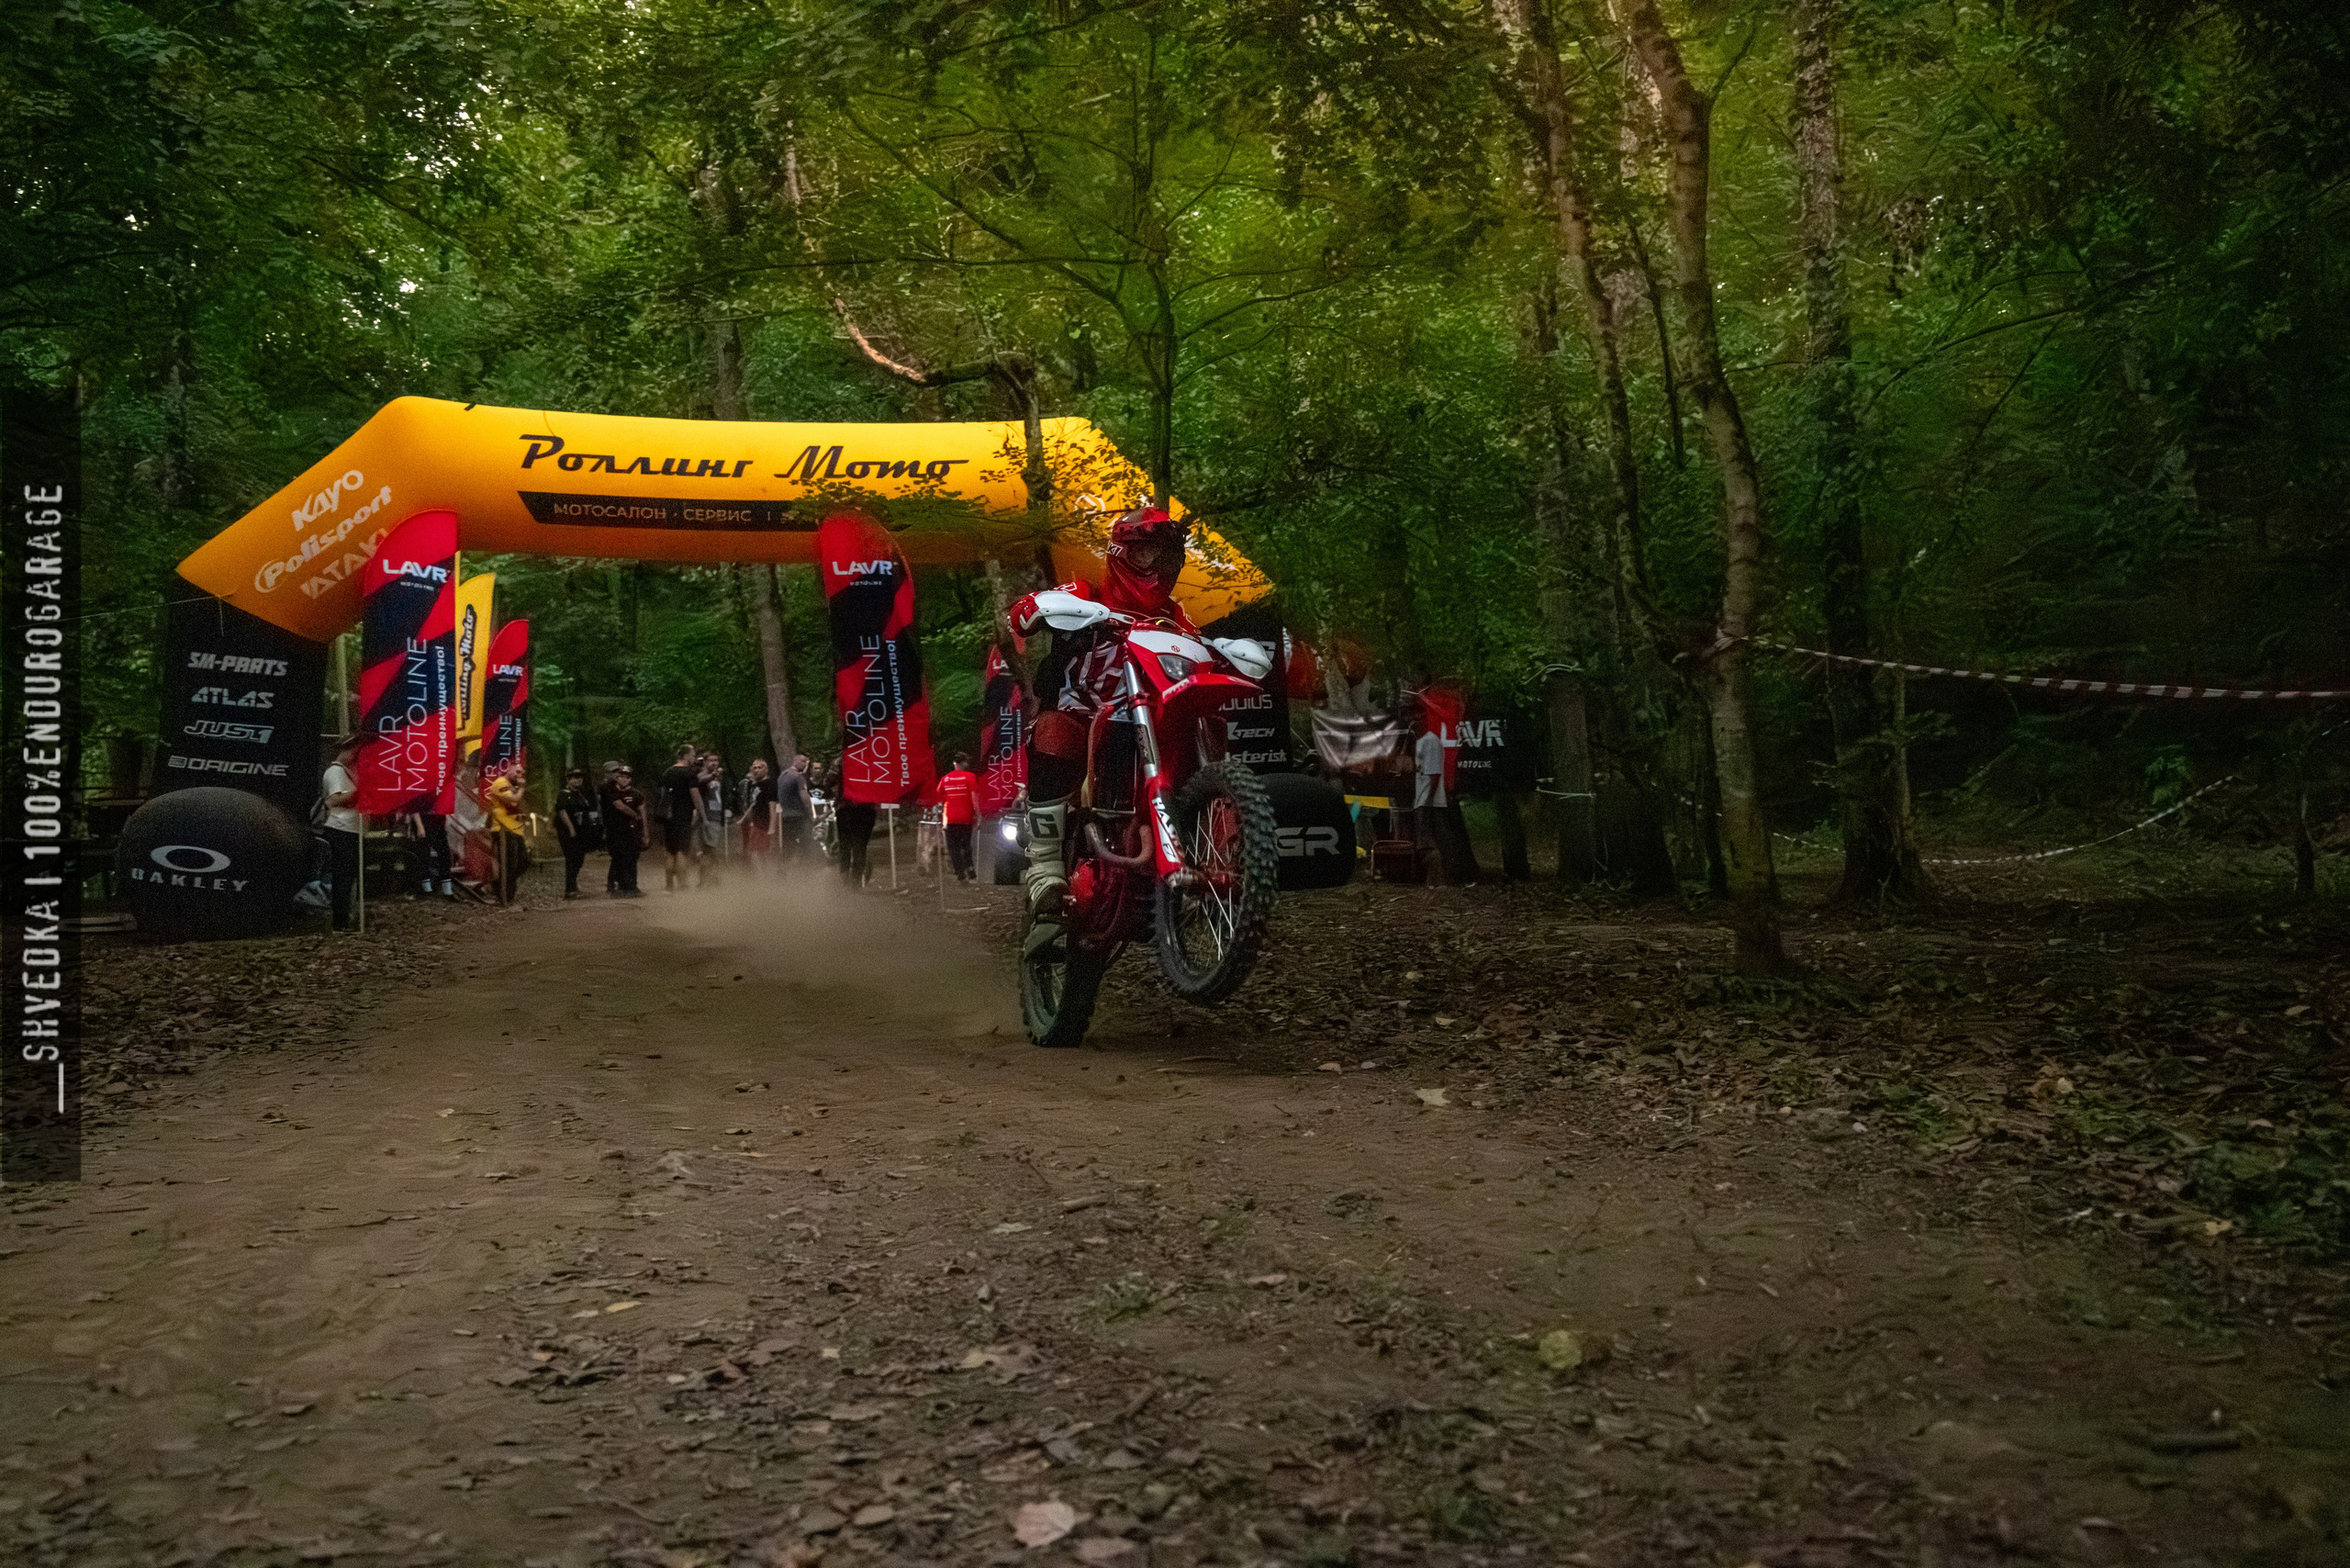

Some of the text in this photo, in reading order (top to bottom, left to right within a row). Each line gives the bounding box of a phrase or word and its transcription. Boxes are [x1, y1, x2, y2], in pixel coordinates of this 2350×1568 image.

[519, 433, 755, 478] Роллинг
[291, 469, 364, 532] KAYO
[554, 503, 753, 522] МОТОСАЛОН СЕРВИС
[261, 485, 392, 589] Polisport
[382, 558, 447, 584] LAVR
[832, 559, 893, 576] LAVR
[187, 651, 289, 677] SM-PARTS
[492, 664, 523, 677] LAVR
[191, 686, 275, 709] ATLAS
[406, 636, 429, 791] MOTOLINE
[859, 633, 892, 783] MOTOLINE
[885, 639, 908, 750] преимущество!
[377, 714, 404, 791] LAVR
[845, 710, 871, 783] LAVR
[1000, 706, 1014, 801] MOTOLINE
[1440, 719, 1505, 748] LAVR
[987, 754, 1001, 801] LAVR
[130, 867, 249, 891] OAKLEY
